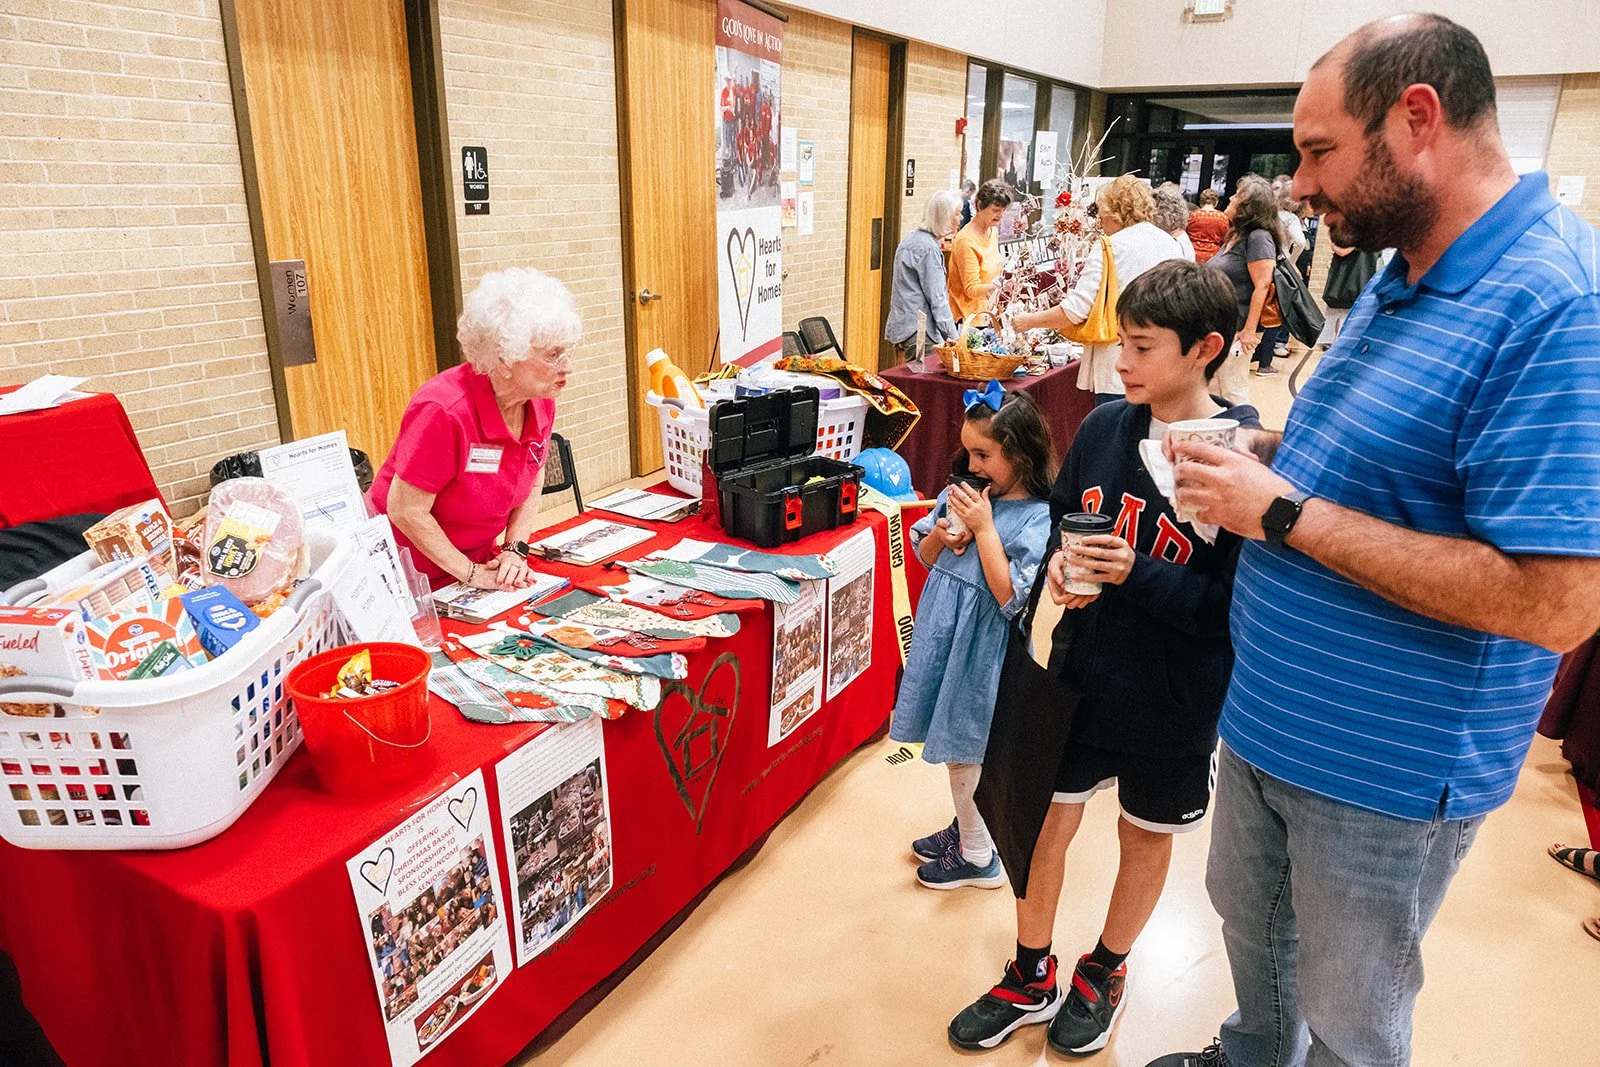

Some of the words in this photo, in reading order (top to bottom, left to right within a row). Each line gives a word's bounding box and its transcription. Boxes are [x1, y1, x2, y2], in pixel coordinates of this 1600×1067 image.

[765, 33, 783, 52] ACTIO
[758, 235, 781, 256] Hearts
[765, 259, 776, 277] for
[285, 269, 296, 315] Women
[295, 273, 306, 293] 107
[757, 283, 781, 304] Homes
[289, 450, 308, 459] Hearts
[318, 442, 338, 451] Homes
[889, 513, 904, 568] CAUTION
[223, 544, 240, 568] HONEY
[233, 551, 244, 565] HAM
[897, 615, 914, 661] DADO
[104, 636, 184, 669] Origial
[384, 822, 411, 845] HEARTS
[412, 814, 426, 826] FOR
[426, 795, 451, 815] HOMES
[417, 825, 425, 834] IS
[393, 844, 432, 876] CHRISTMAS
[432, 826, 456, 847] BASKET
[406, 827, 440, 854] OFFERING
[397, 846, 446, 885] SPONSORSHIPS
[447, 837, 456, 847] TO
[397, 880, 417, 897] BLESS
[417, 845, 460, 881] LOW-INCOME
[418, 868, 446, 892] SENIORS
